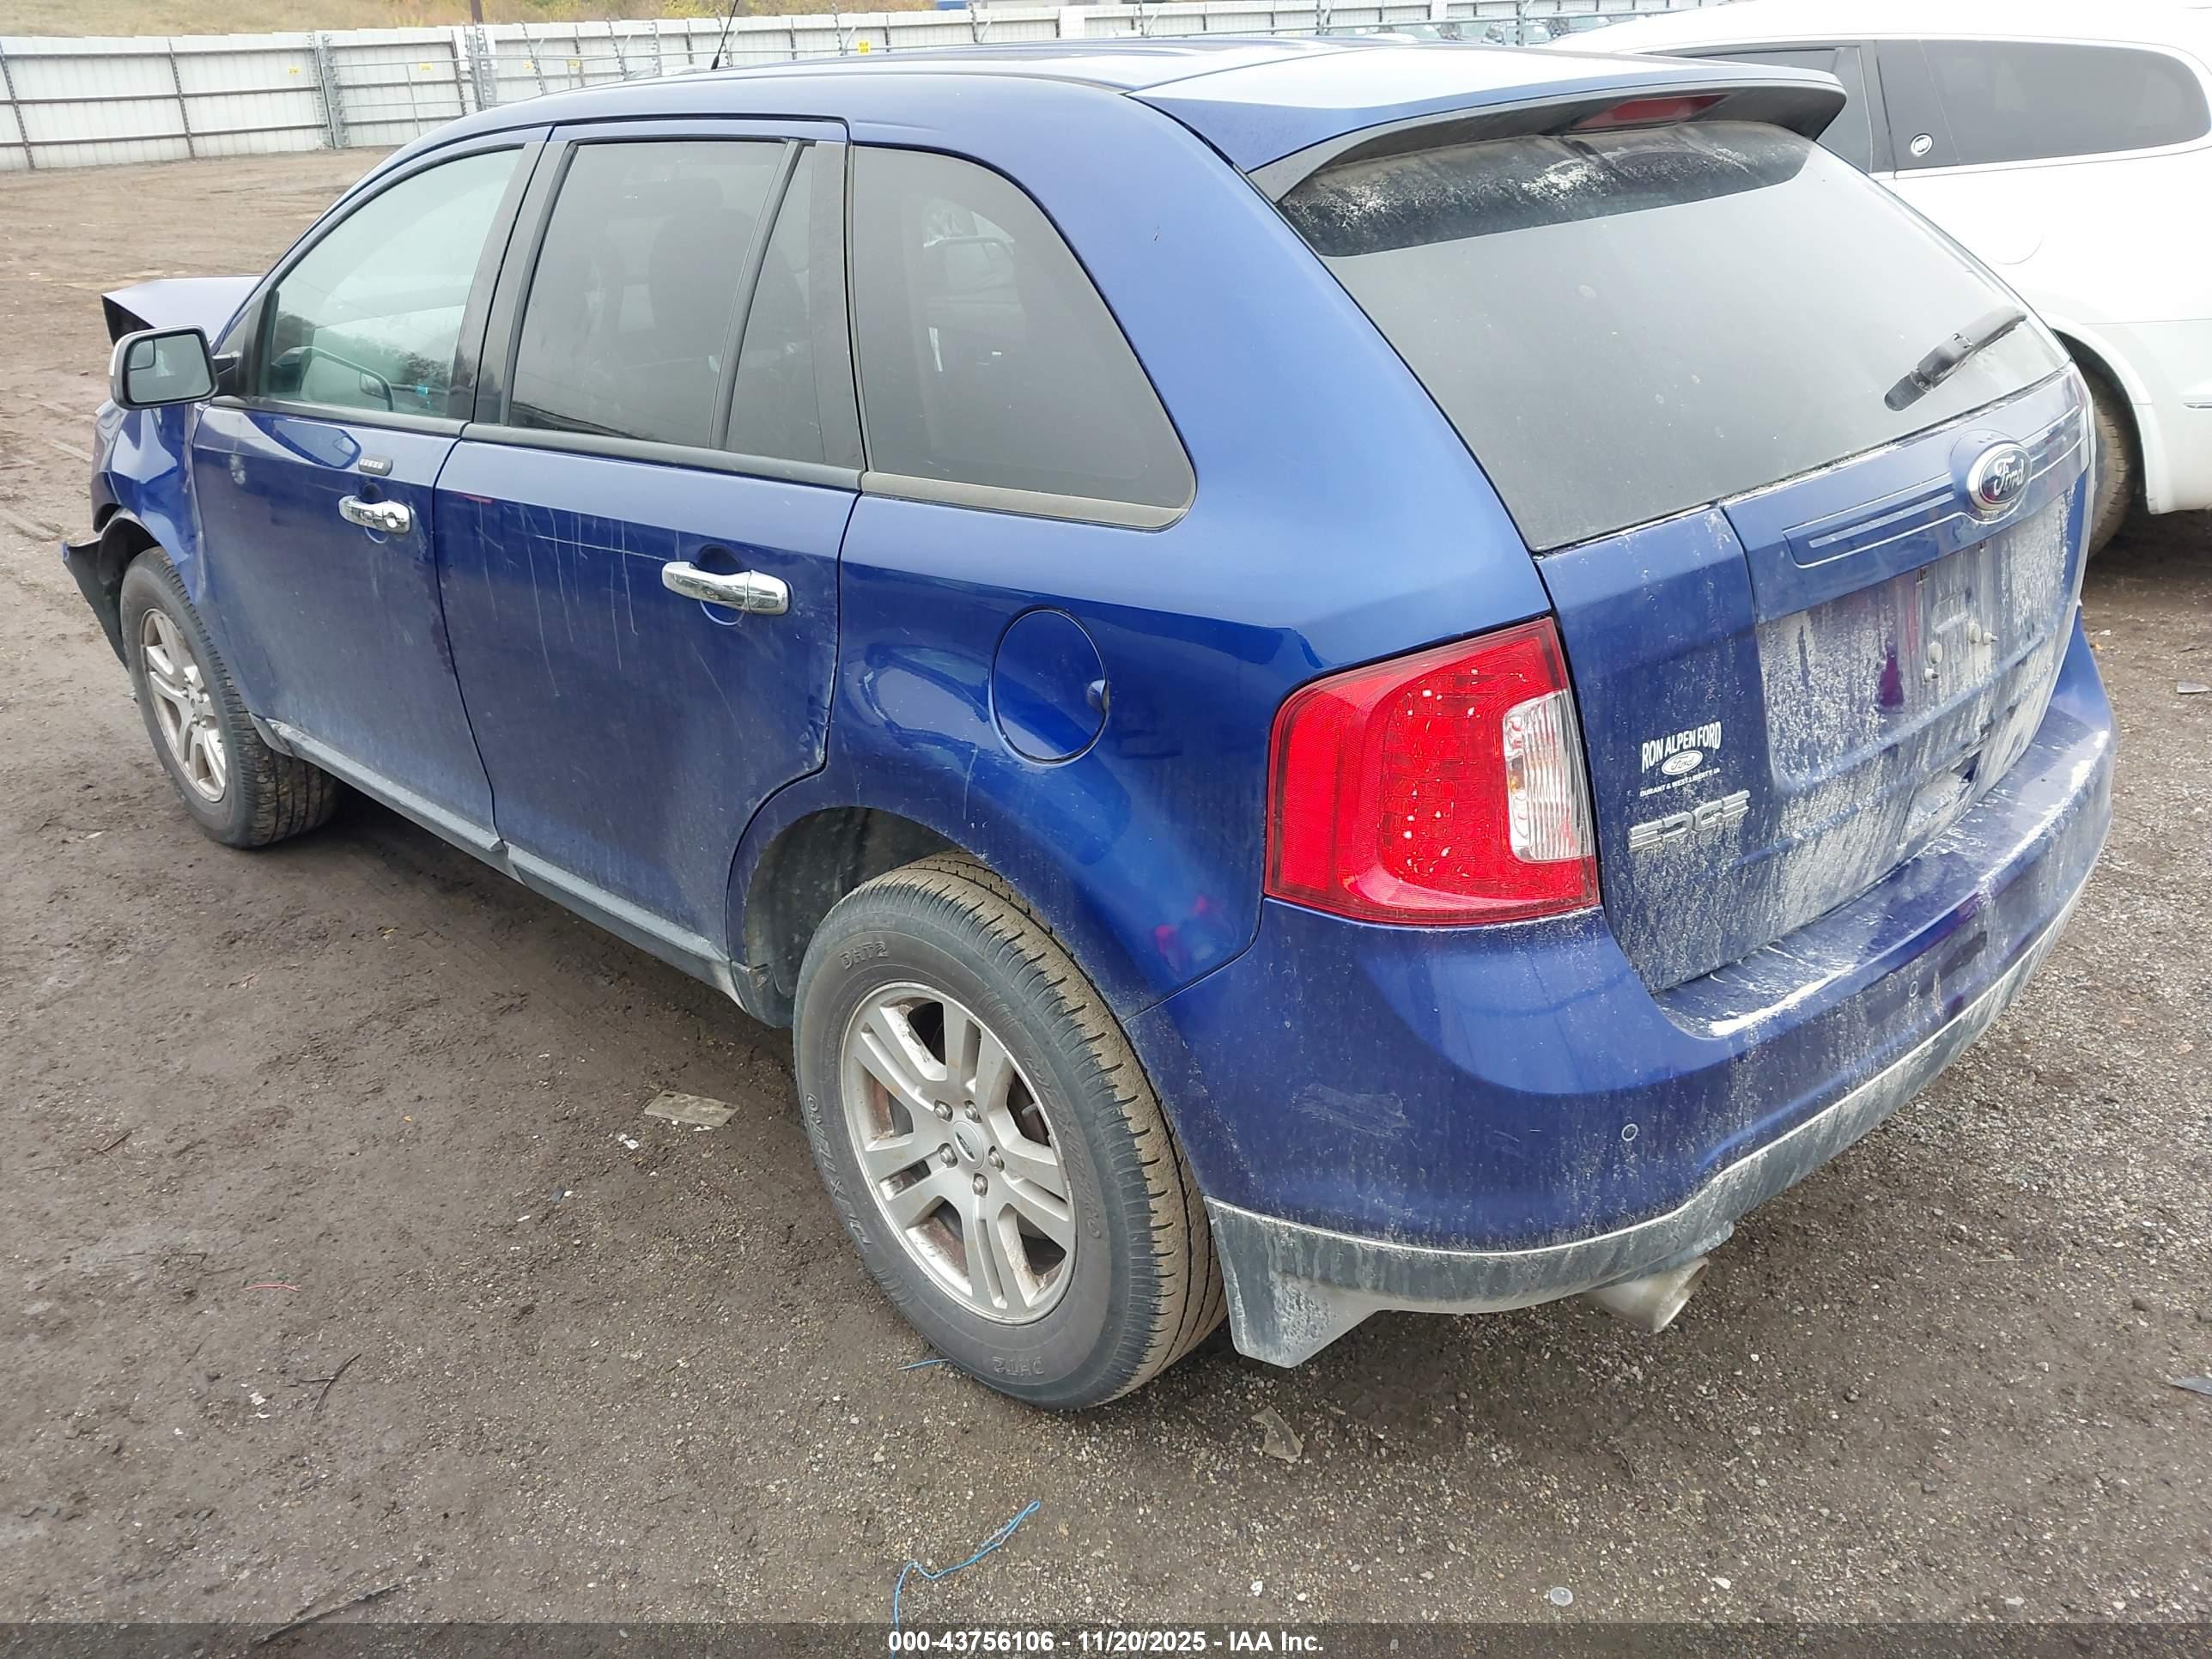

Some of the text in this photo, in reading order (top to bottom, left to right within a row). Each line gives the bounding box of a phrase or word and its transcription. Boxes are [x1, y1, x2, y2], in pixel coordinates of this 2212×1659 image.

[1993, 455, 2025, 496] Ford
[1641, 721, 1722, 774] RON ALPEN FORD
[1670, 756, 1695, 770] Ford
[1639, 784, 1666, 797] DURANT
[1628, 790, 1751, 851] EDGE
[839, 941, 890, 969] DHT2
[991, 1356, 1045, 1376] DHT2
